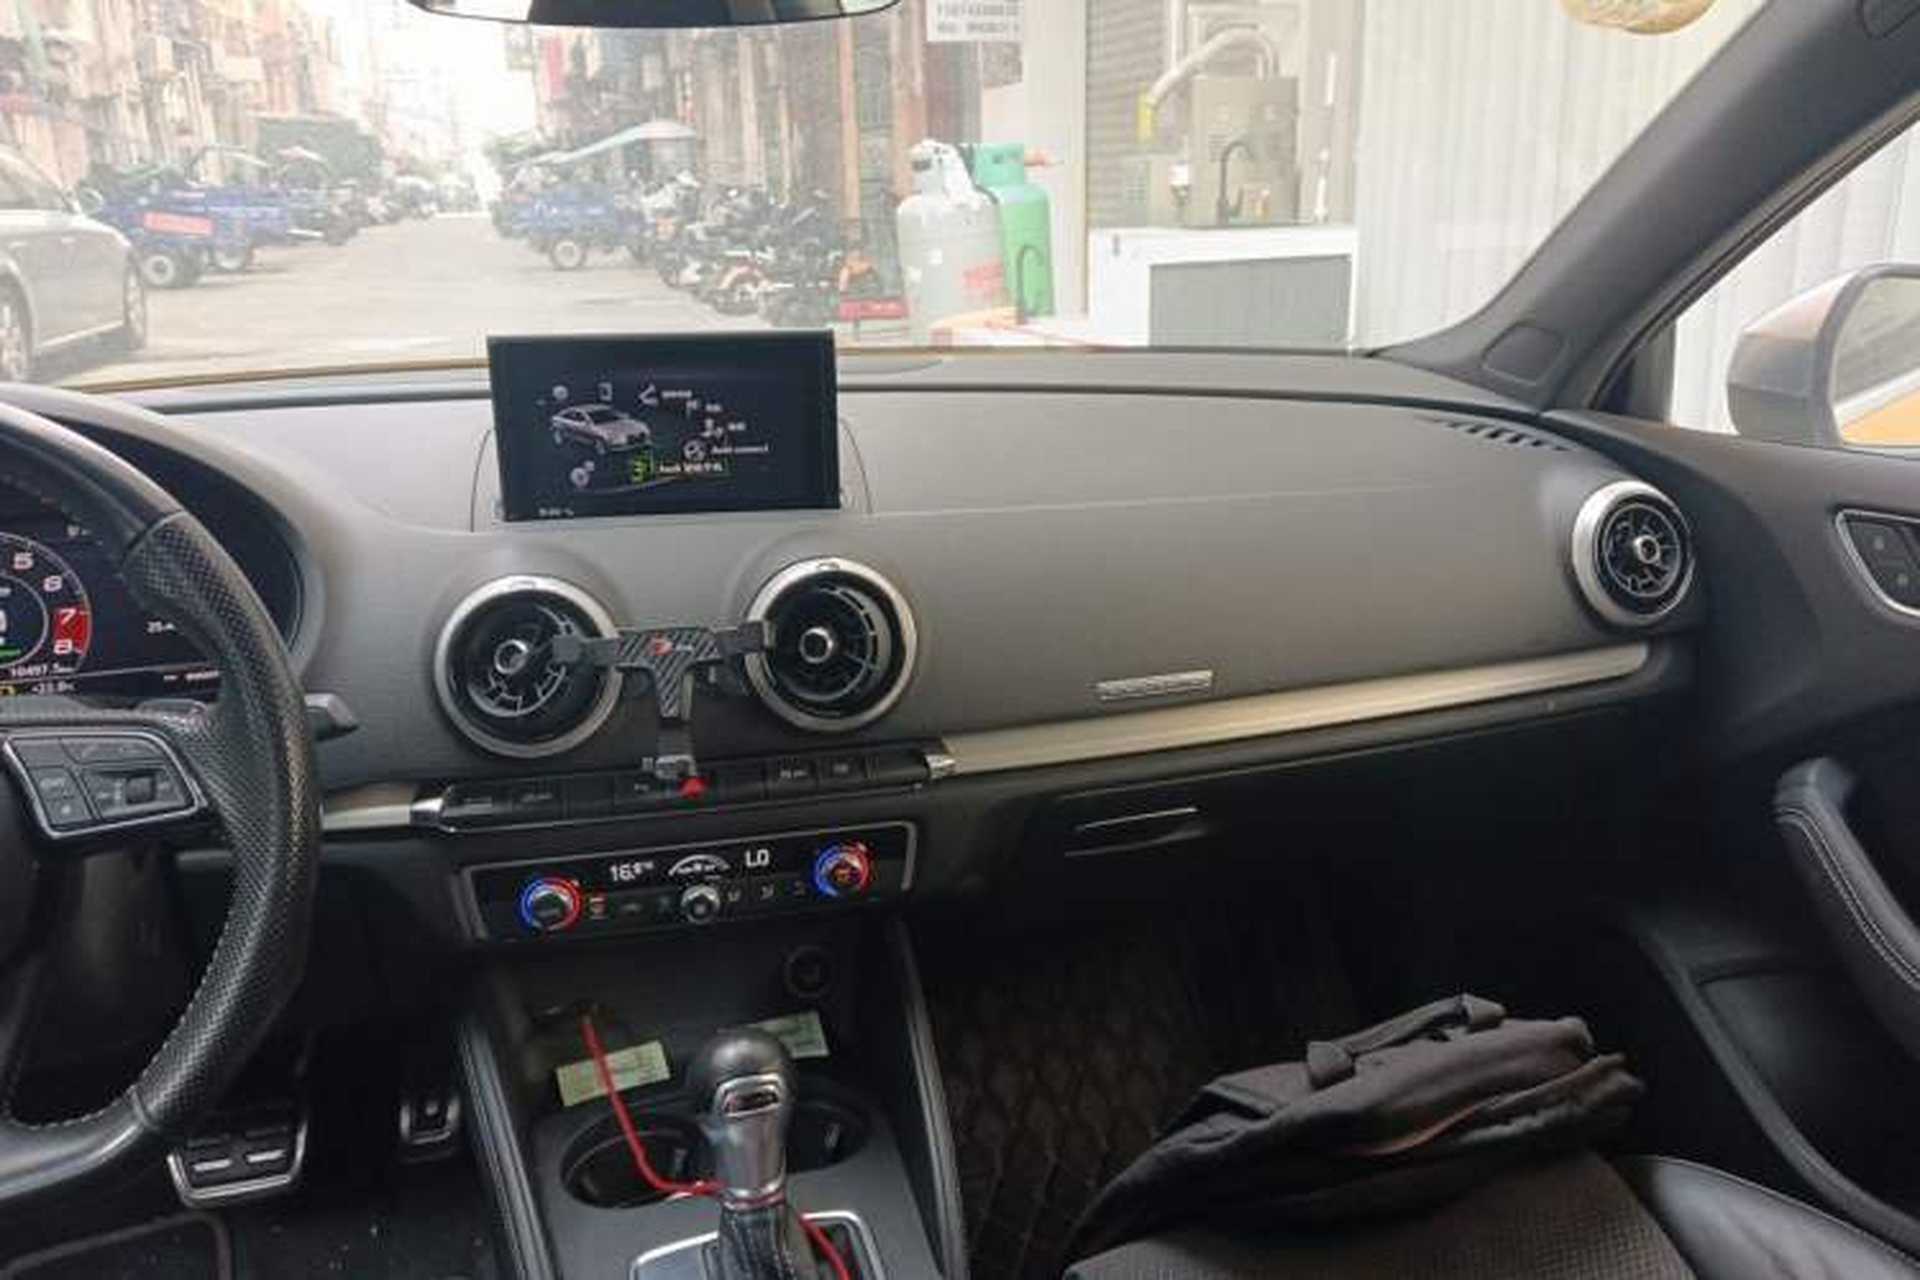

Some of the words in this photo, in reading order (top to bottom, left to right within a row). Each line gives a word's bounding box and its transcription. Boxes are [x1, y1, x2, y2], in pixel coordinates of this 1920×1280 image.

[13, 552, 33, 570] 5
[43, 575, 62, 592] 6
[58, 608, 77, 625] 7
[53, 639, 72, 655] 8
